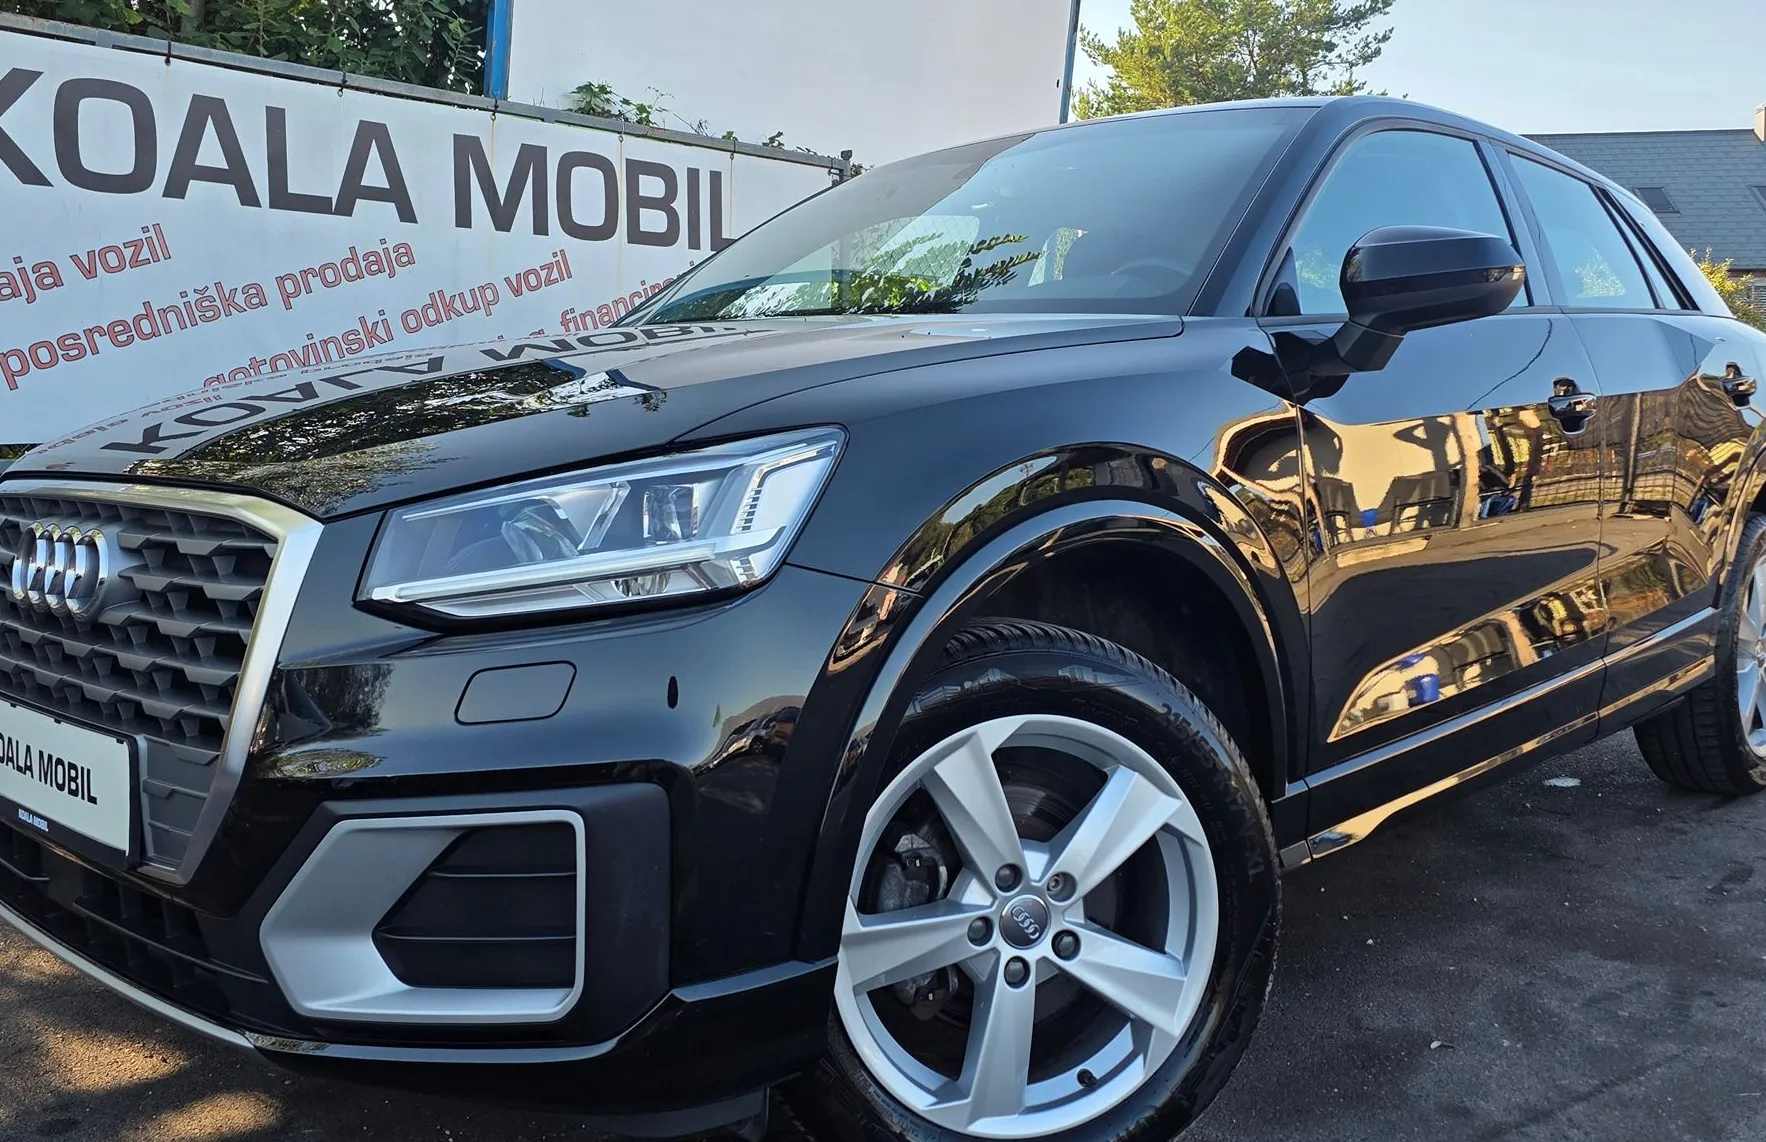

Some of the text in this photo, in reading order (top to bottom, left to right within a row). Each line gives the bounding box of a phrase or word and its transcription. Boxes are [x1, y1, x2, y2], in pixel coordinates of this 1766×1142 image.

[0, 67, 737, 252] KOALA MOBIL
[69, 223, 171, 280] vozil
[400, 289, 500, 335] odkup
[504, 249, 572, 298] vozil
[0, 282, 268, 391] posredniška
[275, 238, 416, 311] prodaja
[38, 749, 98, 806] MOBIL
